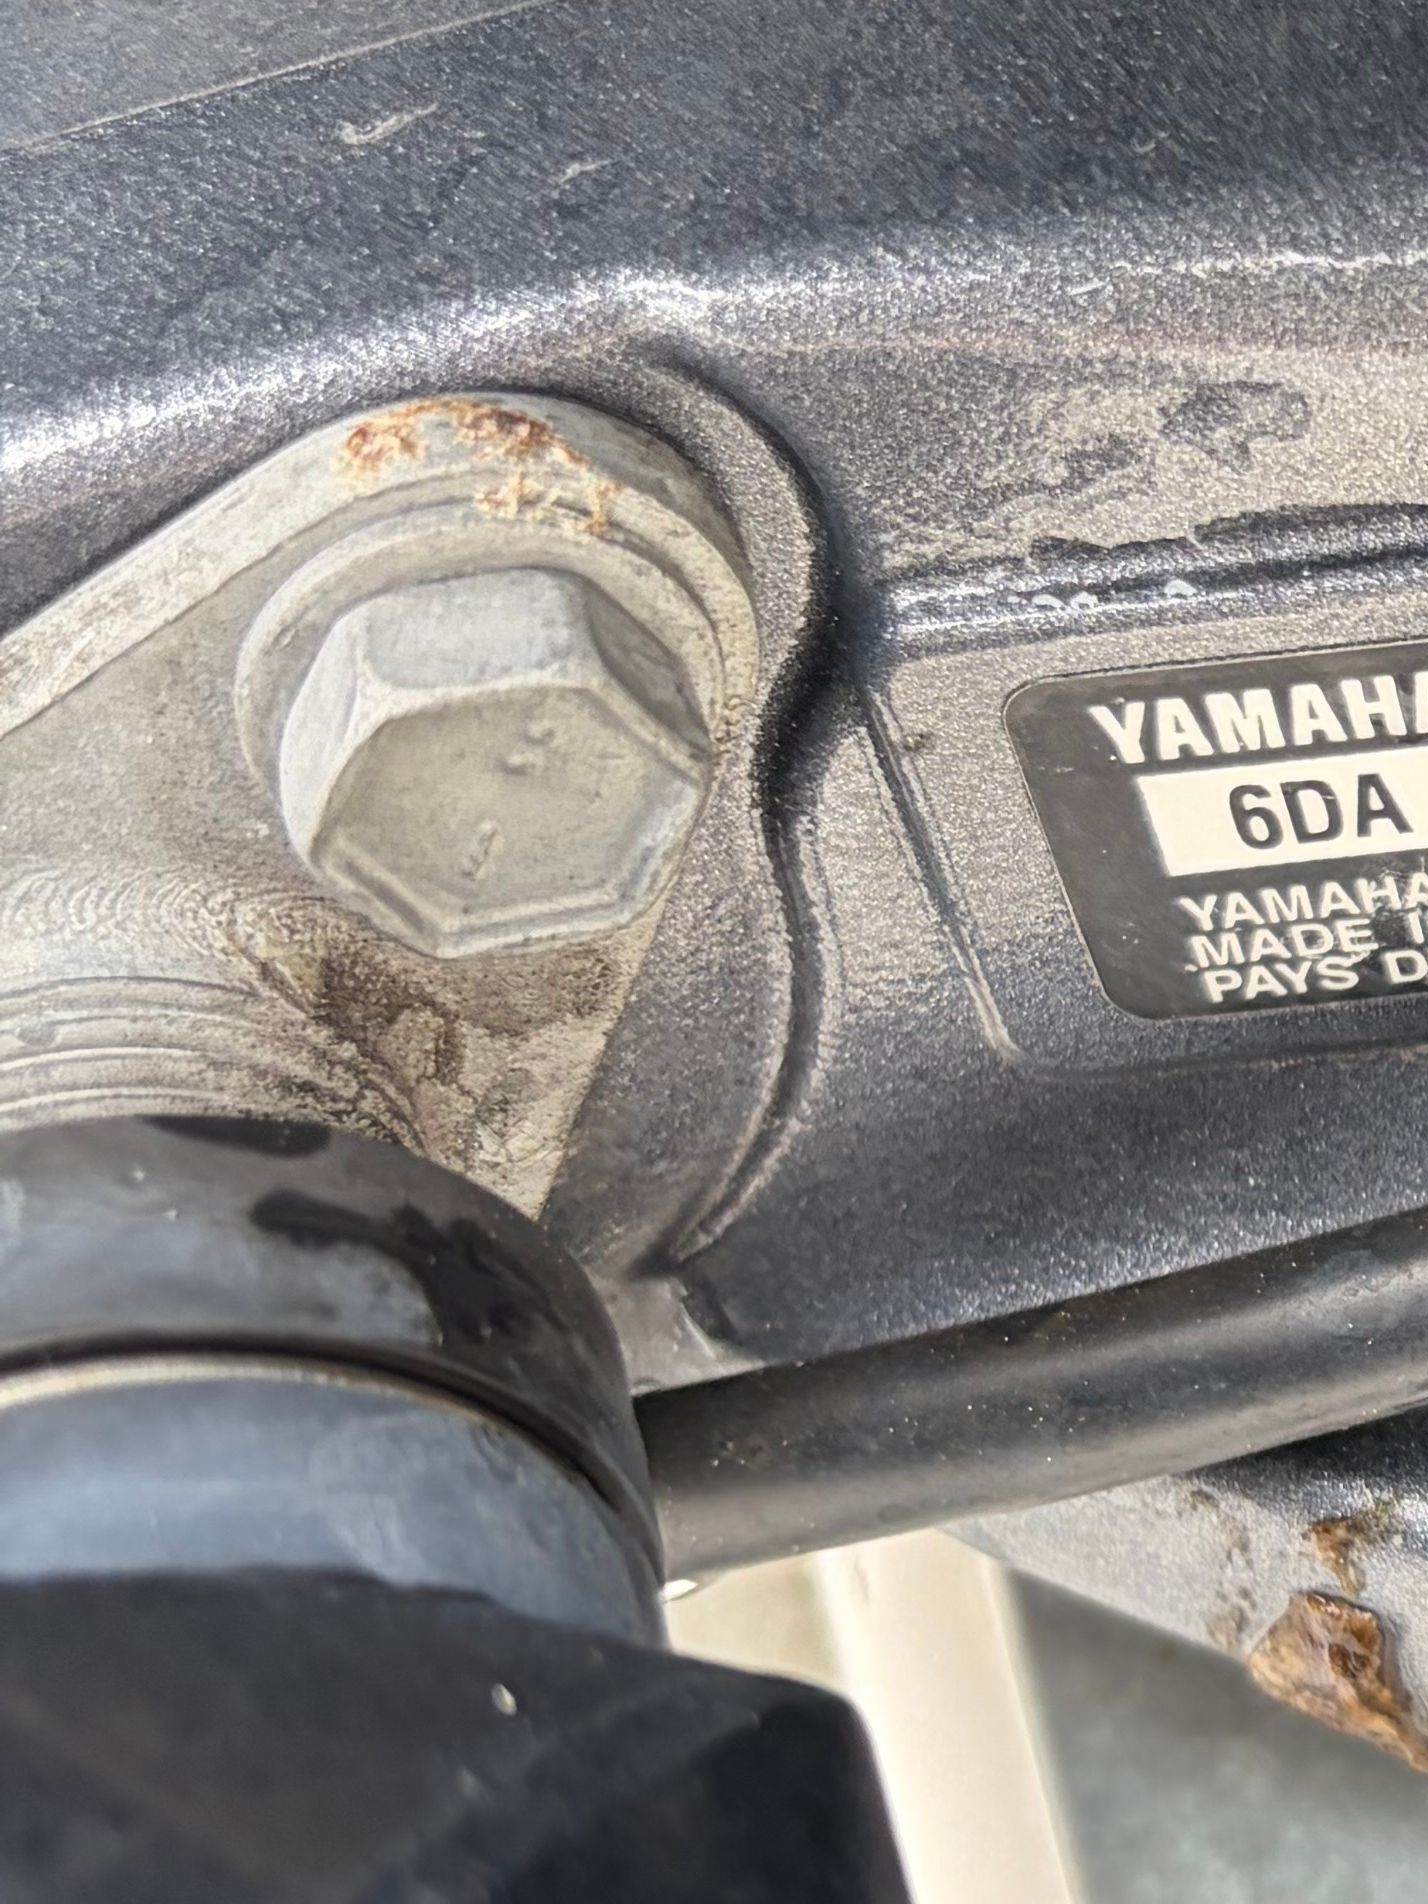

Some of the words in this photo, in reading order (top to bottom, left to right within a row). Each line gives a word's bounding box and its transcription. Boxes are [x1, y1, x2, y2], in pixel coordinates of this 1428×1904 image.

[1228, 772, 1415, 850] 6DA
[1189, 917, 1380, 969] MADE
[1202, 951, 1361, 1004] PAYS
